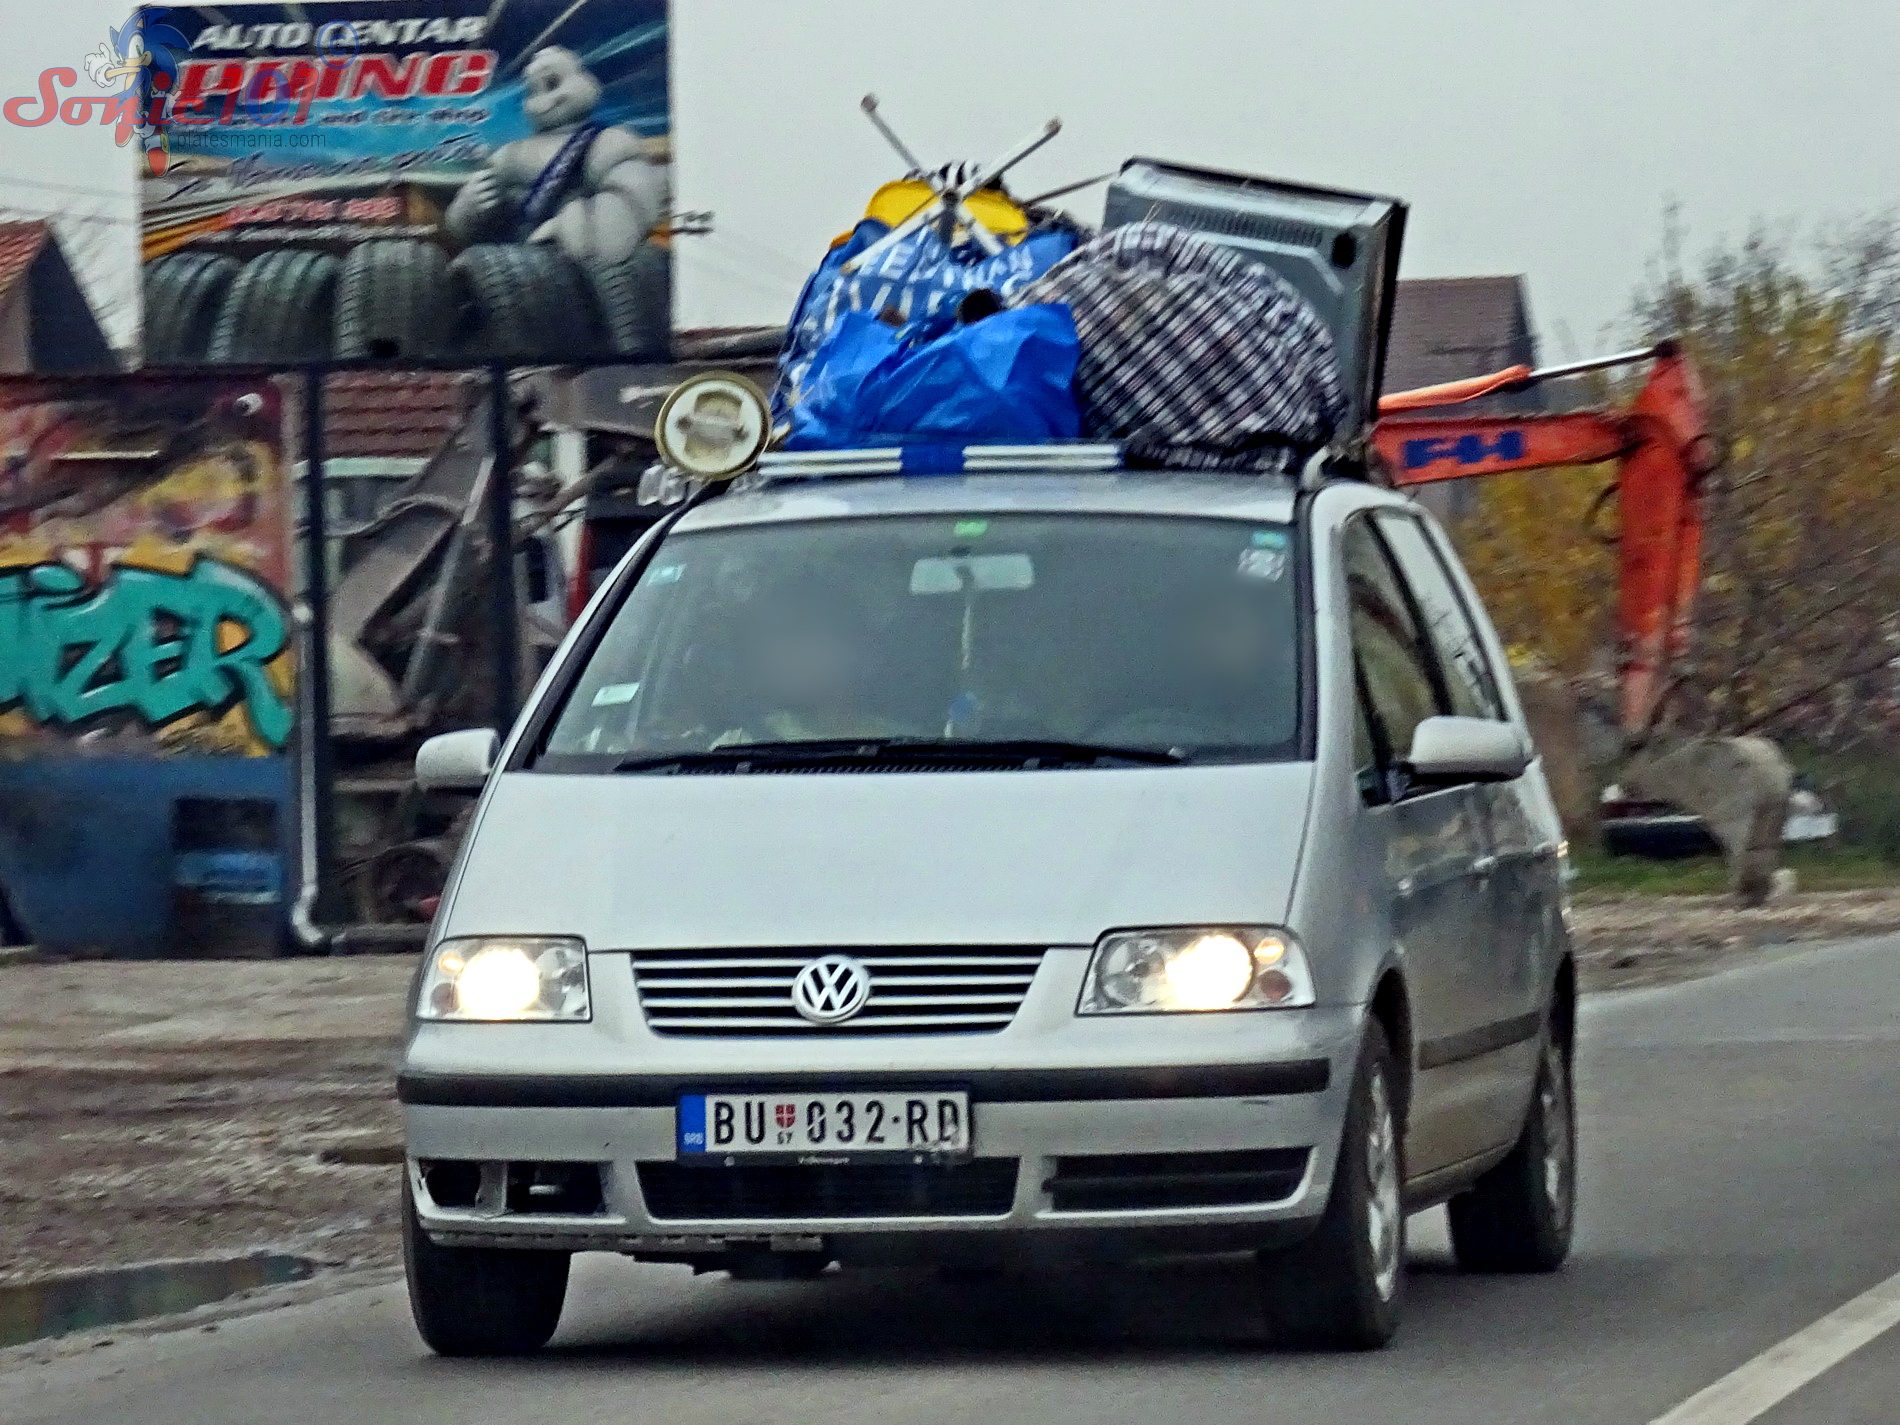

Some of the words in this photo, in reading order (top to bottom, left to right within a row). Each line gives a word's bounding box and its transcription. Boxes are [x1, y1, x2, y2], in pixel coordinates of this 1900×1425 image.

[191, 21, 313, 50] AUTO
[319, 15, 491, 48] CENTAR
[714, 1101, 765, 1145] BU
